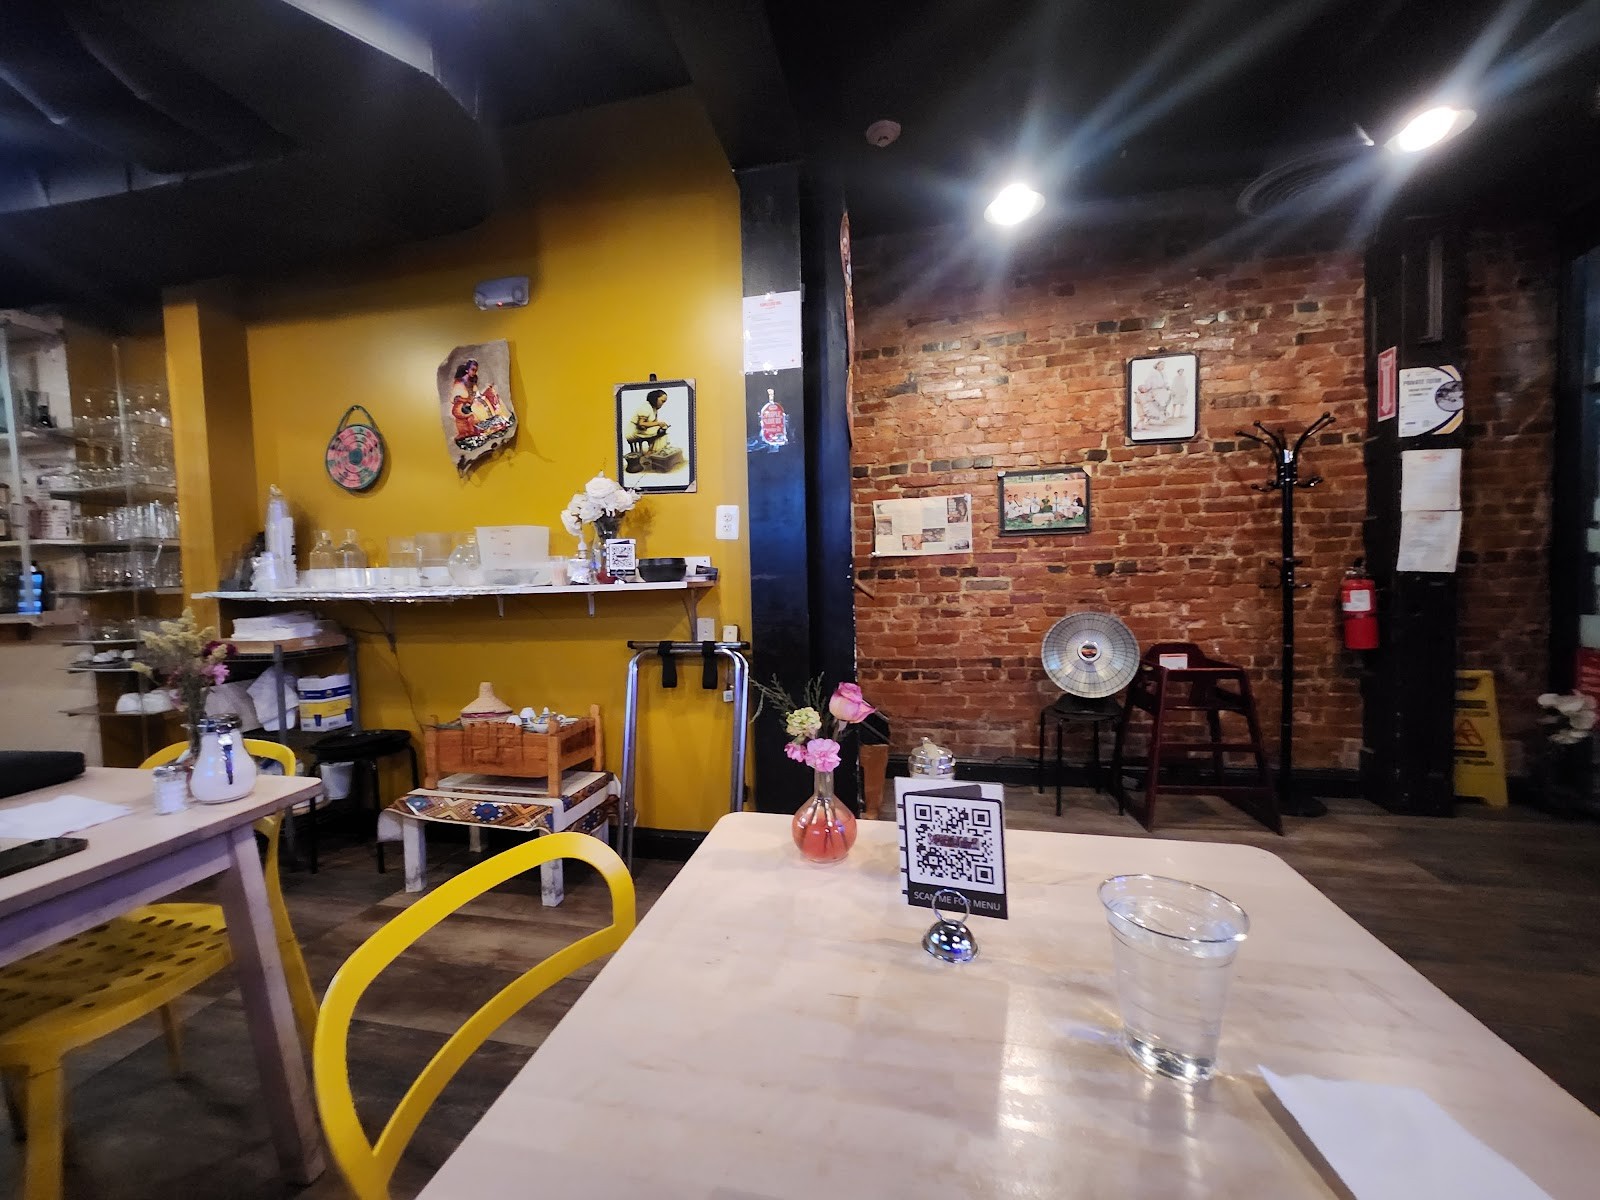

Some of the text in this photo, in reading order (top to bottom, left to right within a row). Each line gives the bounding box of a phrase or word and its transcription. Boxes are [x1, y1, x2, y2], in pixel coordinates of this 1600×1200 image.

[913, 891, 1001, 911] SCAN ME FOR MENU
